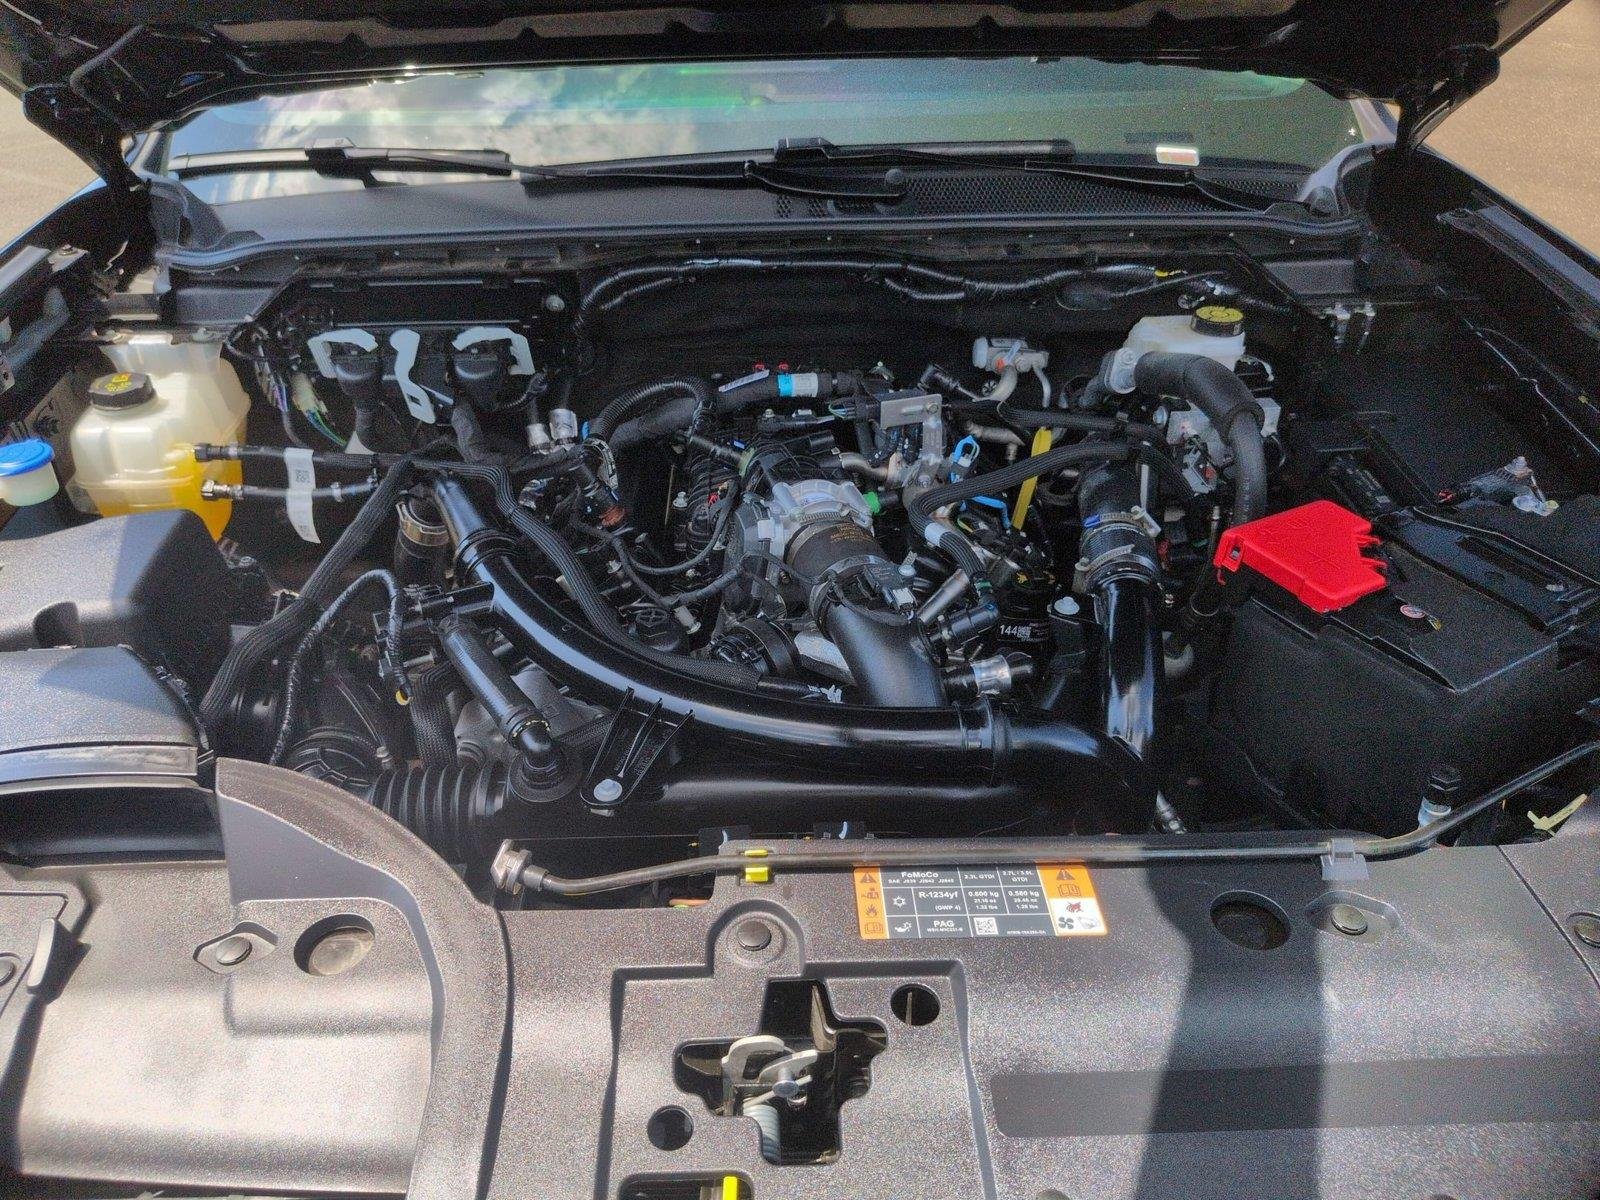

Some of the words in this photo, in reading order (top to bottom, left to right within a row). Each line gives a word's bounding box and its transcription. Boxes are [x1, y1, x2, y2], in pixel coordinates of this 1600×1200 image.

[918, 891, 958, 900] R-1234yf
[989, 890, 999, 898] kg
[933, 919, 955, 928] PAG
